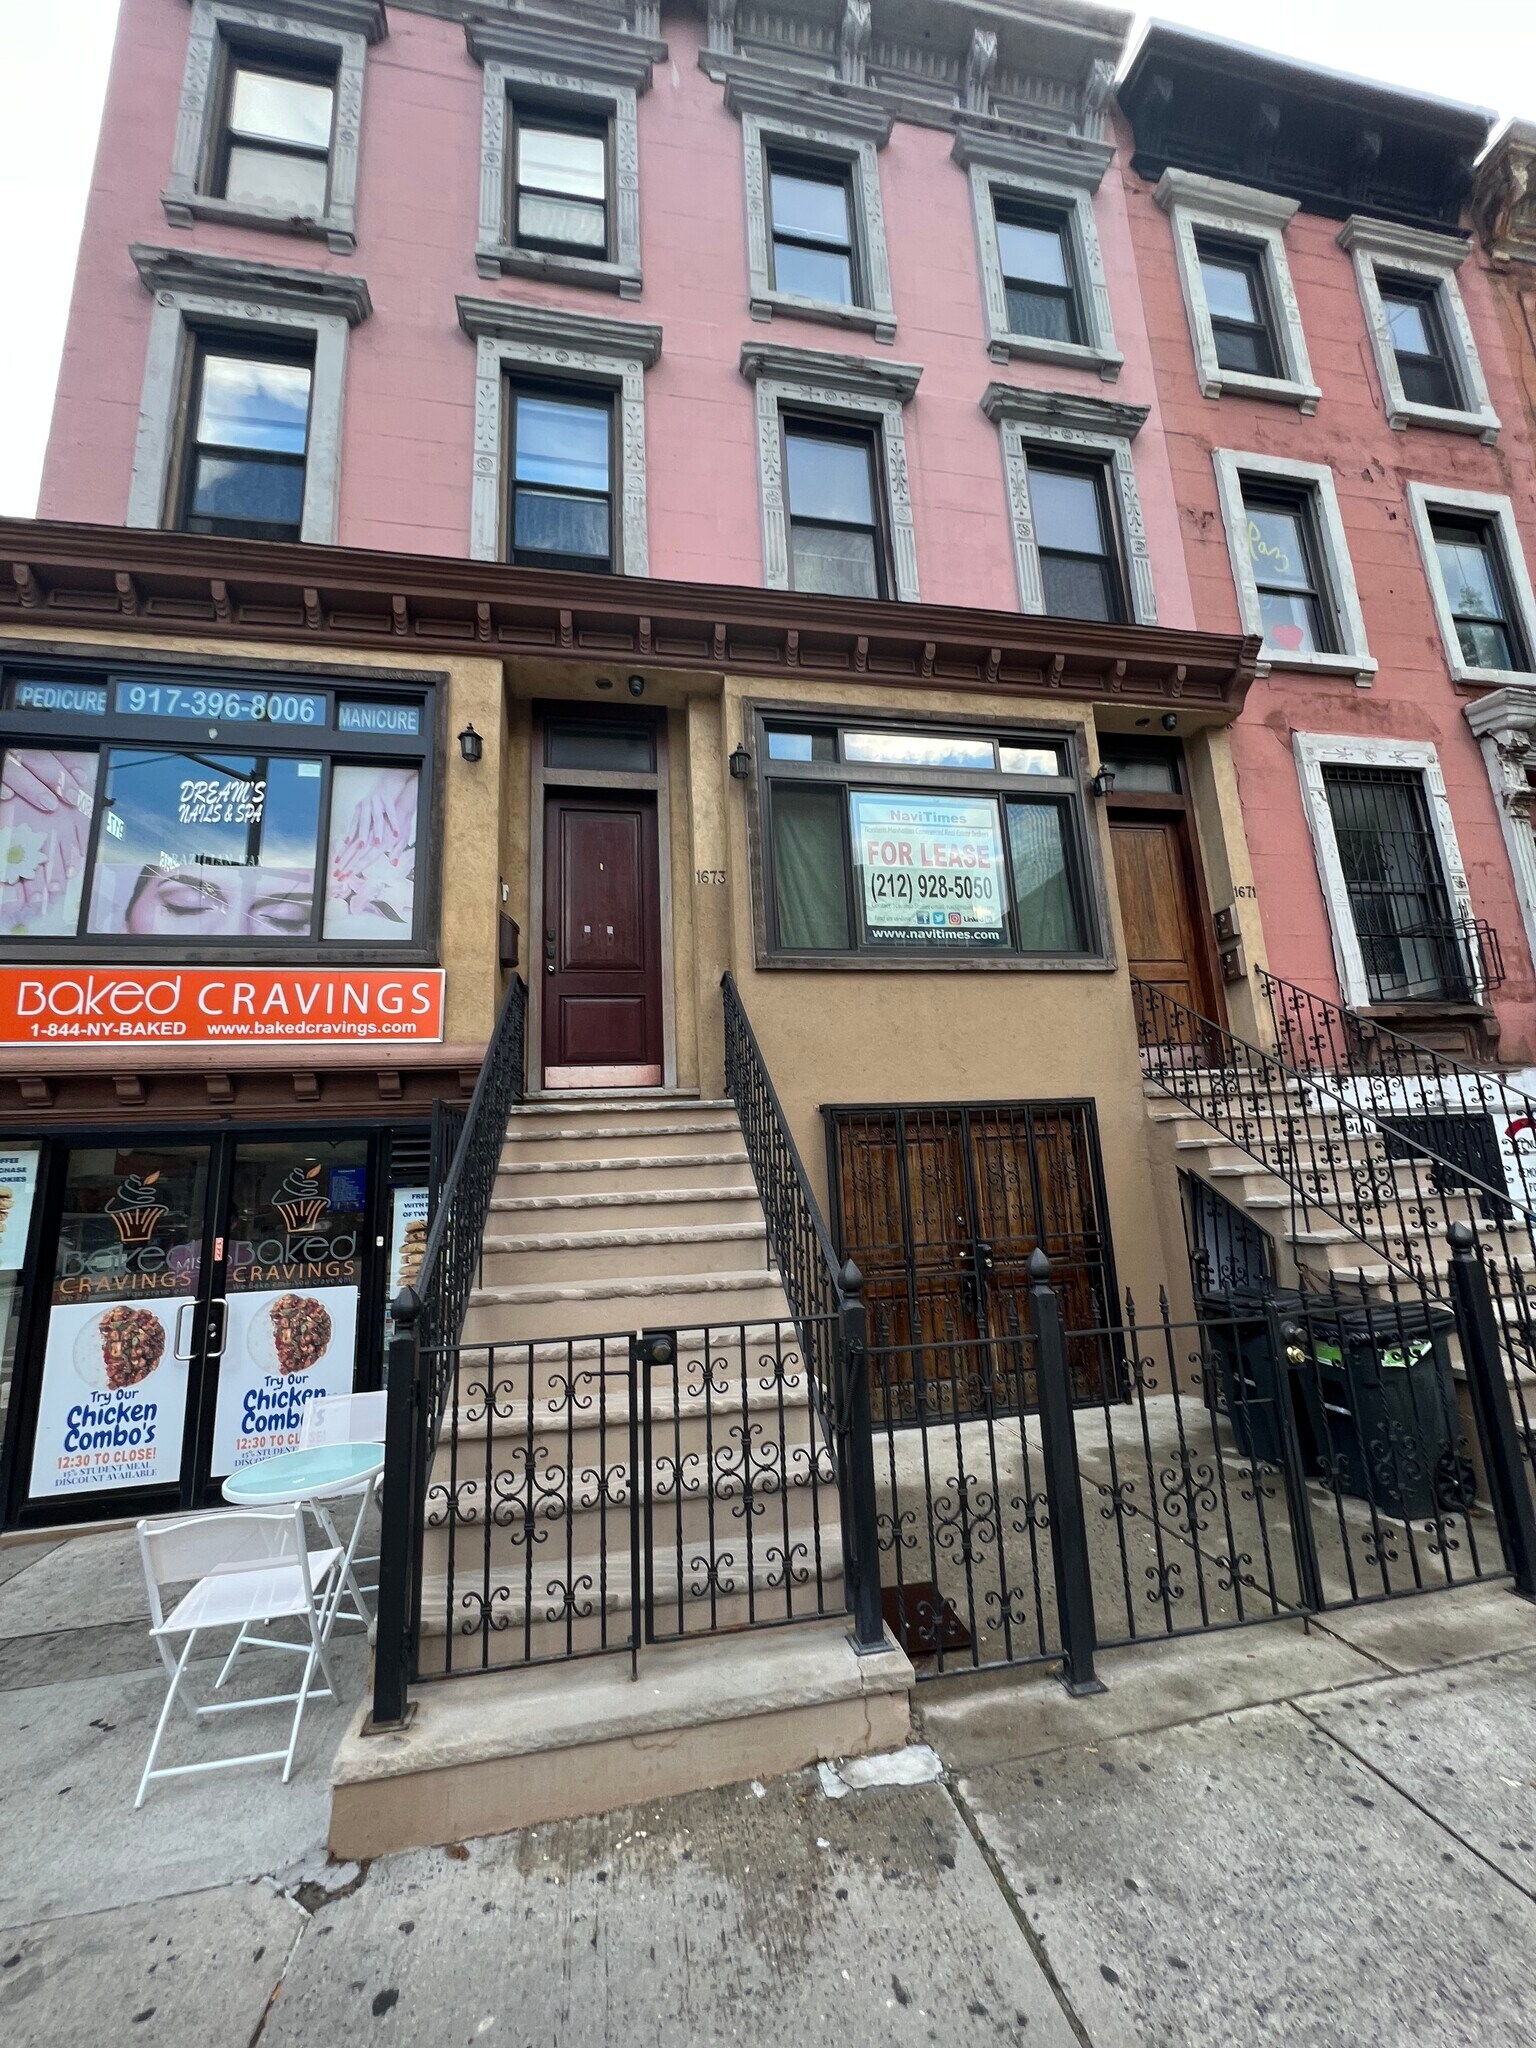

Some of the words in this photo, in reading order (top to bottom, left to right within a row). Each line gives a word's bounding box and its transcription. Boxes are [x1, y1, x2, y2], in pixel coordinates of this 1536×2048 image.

[21, 686, 107, 712] PEDICURE
[129, 686, 315, 722] 917-396-8006
[339, 706, 417, 730] MANICURE
[179, 781, 267, 804] DREAM'S
[178, 803, 221, 824] NAILS
[224, 805, 233, 822] &
[235, 803, 264, 824] SPA
[890, 810, 967, 824] NaviTimes
[868, 841, 914, 866] FOR
[920, 842, 991, 869] LEASE
[696, 870, 726, 884] 1673
[871, 873, 913, 904] (212)
[918, 874, 993, 899] 928-5050
[1233, 885, 1257, 898] 1671
[872, 929, 1000, 941] www.navitimes.com
[17, 975, 182, 1015] Baked
[198, 982, 431, 1015] CRAVINGS
[30, 1022, 187, 1037] 1-844-NY-BAKED
[207, 1021, 417, 1037] www.bakedcravings.com
[234, 1230, 357, 1266] Baked
[60, 1270, 192, 1294] CRAVINGS
[233, 1260, 355, 1283] CRAVINGS
[264, 1375, 284, 1391] Try
[287, 1374, 309, 1384] Our
[90, 1391, 112, 1407] Try
[116, 1389, 139, 1400] Our
[243, 1386, 326, 1413] Chicken
[67, 1402, 157, 1429] Chicken
[64, 1422, 157, 1452] Combo's
[236, 1436, 266, 1451] 12:30
[270, 1434, 284, 1447] TO
[57, 1454, 91, 1469] 12:30
[95, 1452, 110, 1465] TO
[114, 1447, 157, 1463] CLOSE!
[80, 1464, 125, 1475] STUDENT
[126, 1461, 152, 1471] MEAL
[55, 1474, 106, 1487] DISCOUNT
[106, 1468, 158, 1480] AVAILABLE
